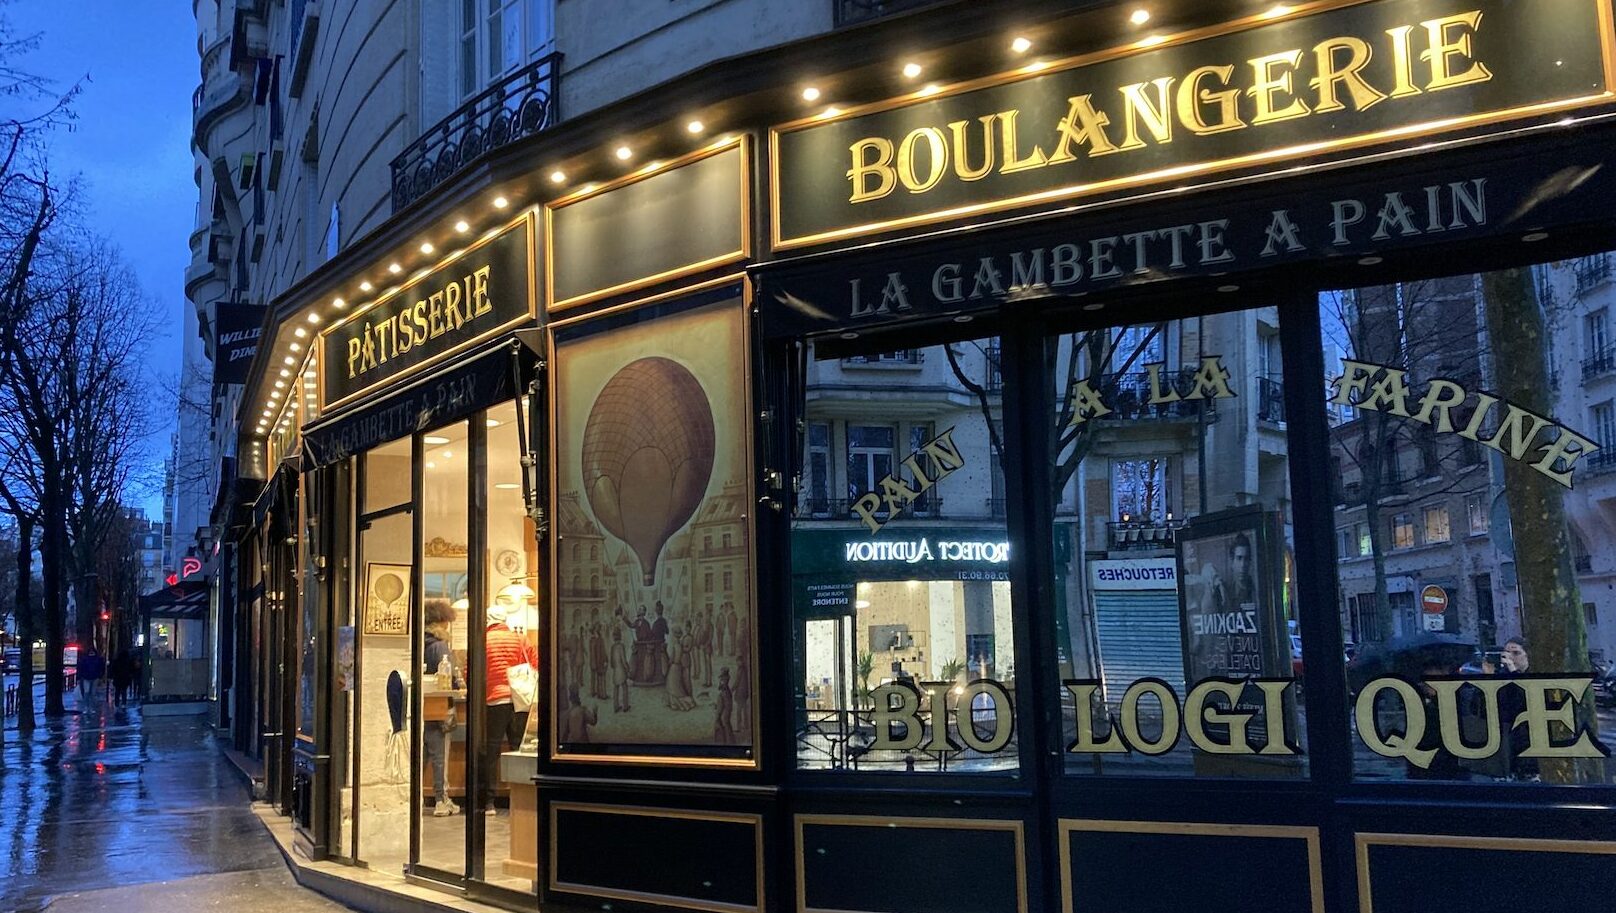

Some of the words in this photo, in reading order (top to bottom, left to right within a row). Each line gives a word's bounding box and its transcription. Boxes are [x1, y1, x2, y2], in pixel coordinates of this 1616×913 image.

[846, 10, 1493, 204] BOULANGERIE
[850, 272, 912, 317] LA
[932, 219, 1236, 304] GAMBETTE
[1260, 210, 1306, 257] A
[1329, 178, 1487, 245] PAIN
[347, 265, 493, 379] PÂTISSERIE
[340, 399, 415, 452] GAMBETTE
[851, 426, 965, 535] PAIN
[1068, 379, 1112, 427] A
[1141, 354, 1237, 405] LA
[1327, 357, 1600, 490] FARINE
[867, 679, 1015, 754] BIO
[1063, 677, 1304, 756] LOGI
[1355, 673, 1611, 770] QUE
